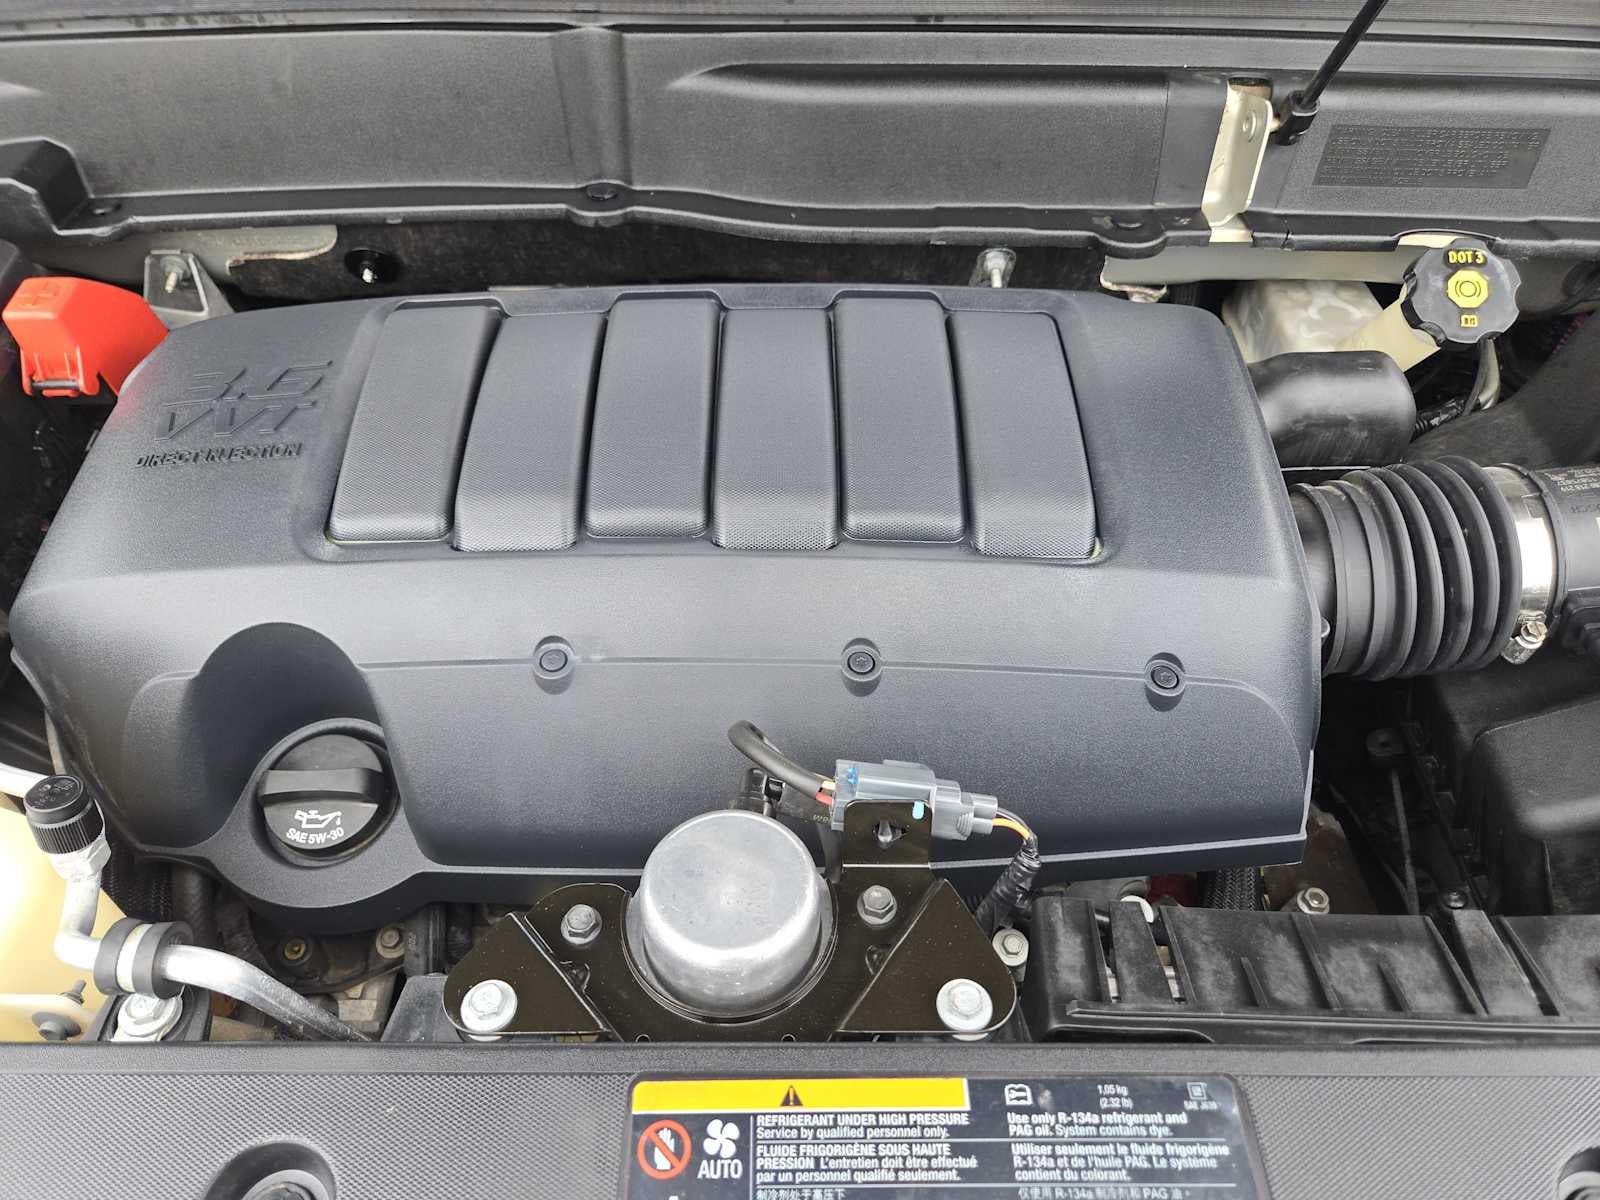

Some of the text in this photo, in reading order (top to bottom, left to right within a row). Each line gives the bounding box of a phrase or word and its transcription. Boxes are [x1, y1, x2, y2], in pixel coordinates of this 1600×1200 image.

[1448, 250, 1485, 264] DOT 3
[153, 401, 317, 442] VVT
[286, 827, 345, 844] SAE 5W-30
[756, 1112, 970, 1126] REFRIGERANT UNDER HIGH PRESSURE
[1007, 1111, 1188, 1126] Use only R-134a refrigerant and
[756, 1125, 950, 1140] Service by qualified personnel only.
[1009, 1124, 1173, 1138] PAG oil. System contains dye.
[756, 1142, 951, 1157] FLUIDE FRIGORIGÈNE SOUS HAUTE
[1011, 1142, 1230, 1157] Utiliser seulement le fluide frigorigène
[697, 1159, 743, 1179] AUTO
[756, 1154, 978, 1169] PRESSION L'entretien doit être effectué
[1013, 1155, 1218, 1171] R-134a et de l'huile PAG. Le système
[756, 1168, 960, 1184] par un personnel qualifié seulement.
[1015, 1168, 1131, 1180] contient du colorant.
[1143, 1187, 1168, 1200] PAG
